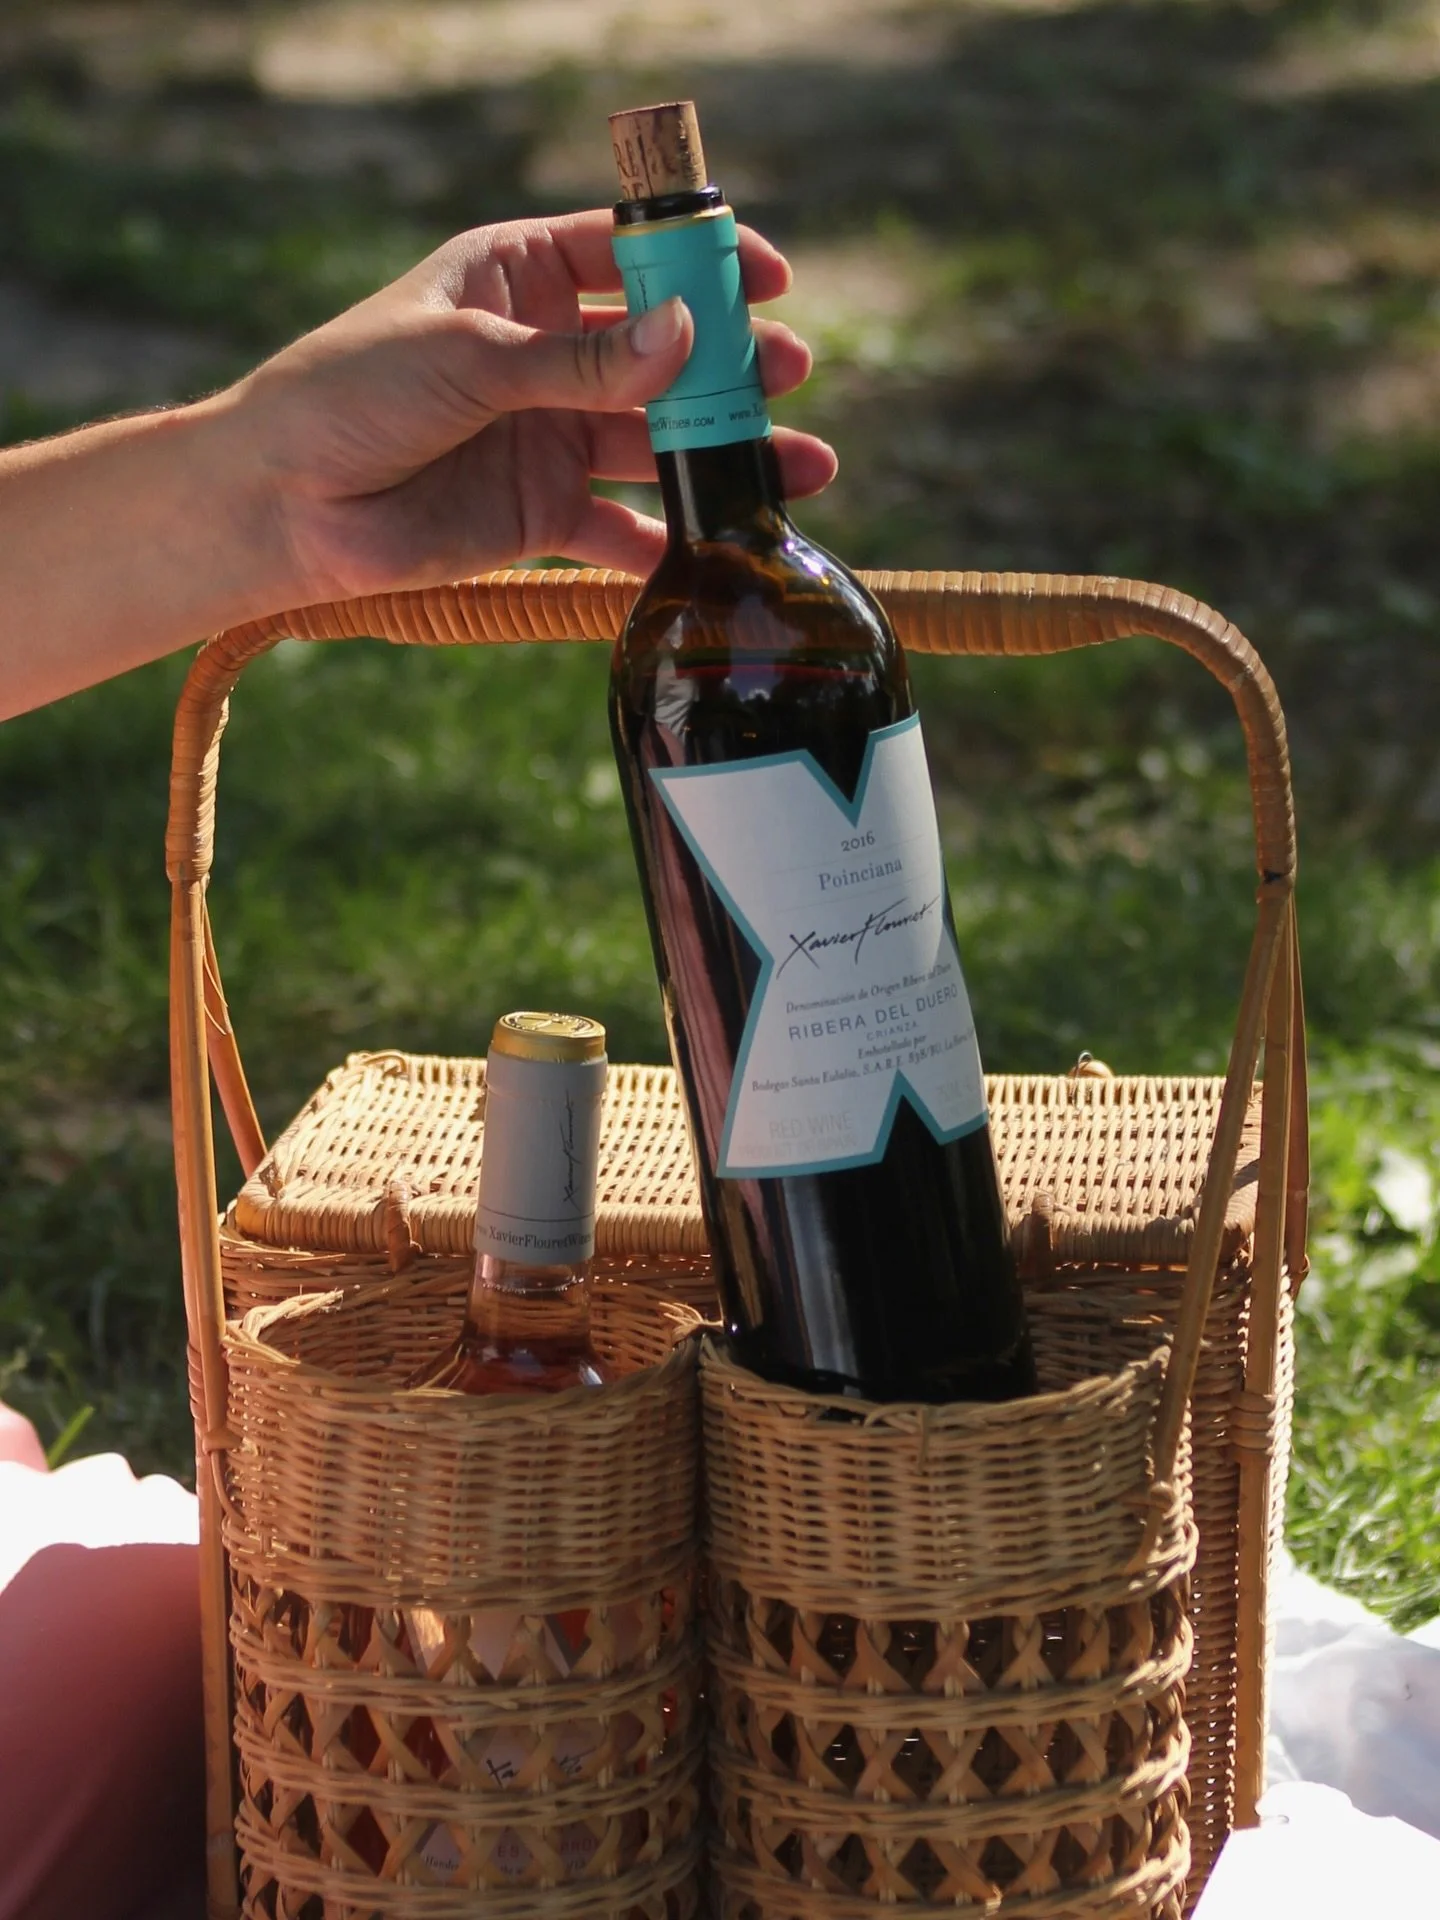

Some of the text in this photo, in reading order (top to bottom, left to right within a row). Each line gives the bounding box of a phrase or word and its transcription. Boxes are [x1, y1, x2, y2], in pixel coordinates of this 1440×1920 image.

[841, 831, 876, 852] 2016
[818, 858, 903, 891] Poinciana
[788, 983, 958, 1041] RIBERA DEL DUERO
[866, 1020, 919, 1042] CRIANZA
[752, 1079, 789, 1094] Bodegas
[791, 1075, 821, 1088] Santa
[806, 1110, 854, 1135] WINE
